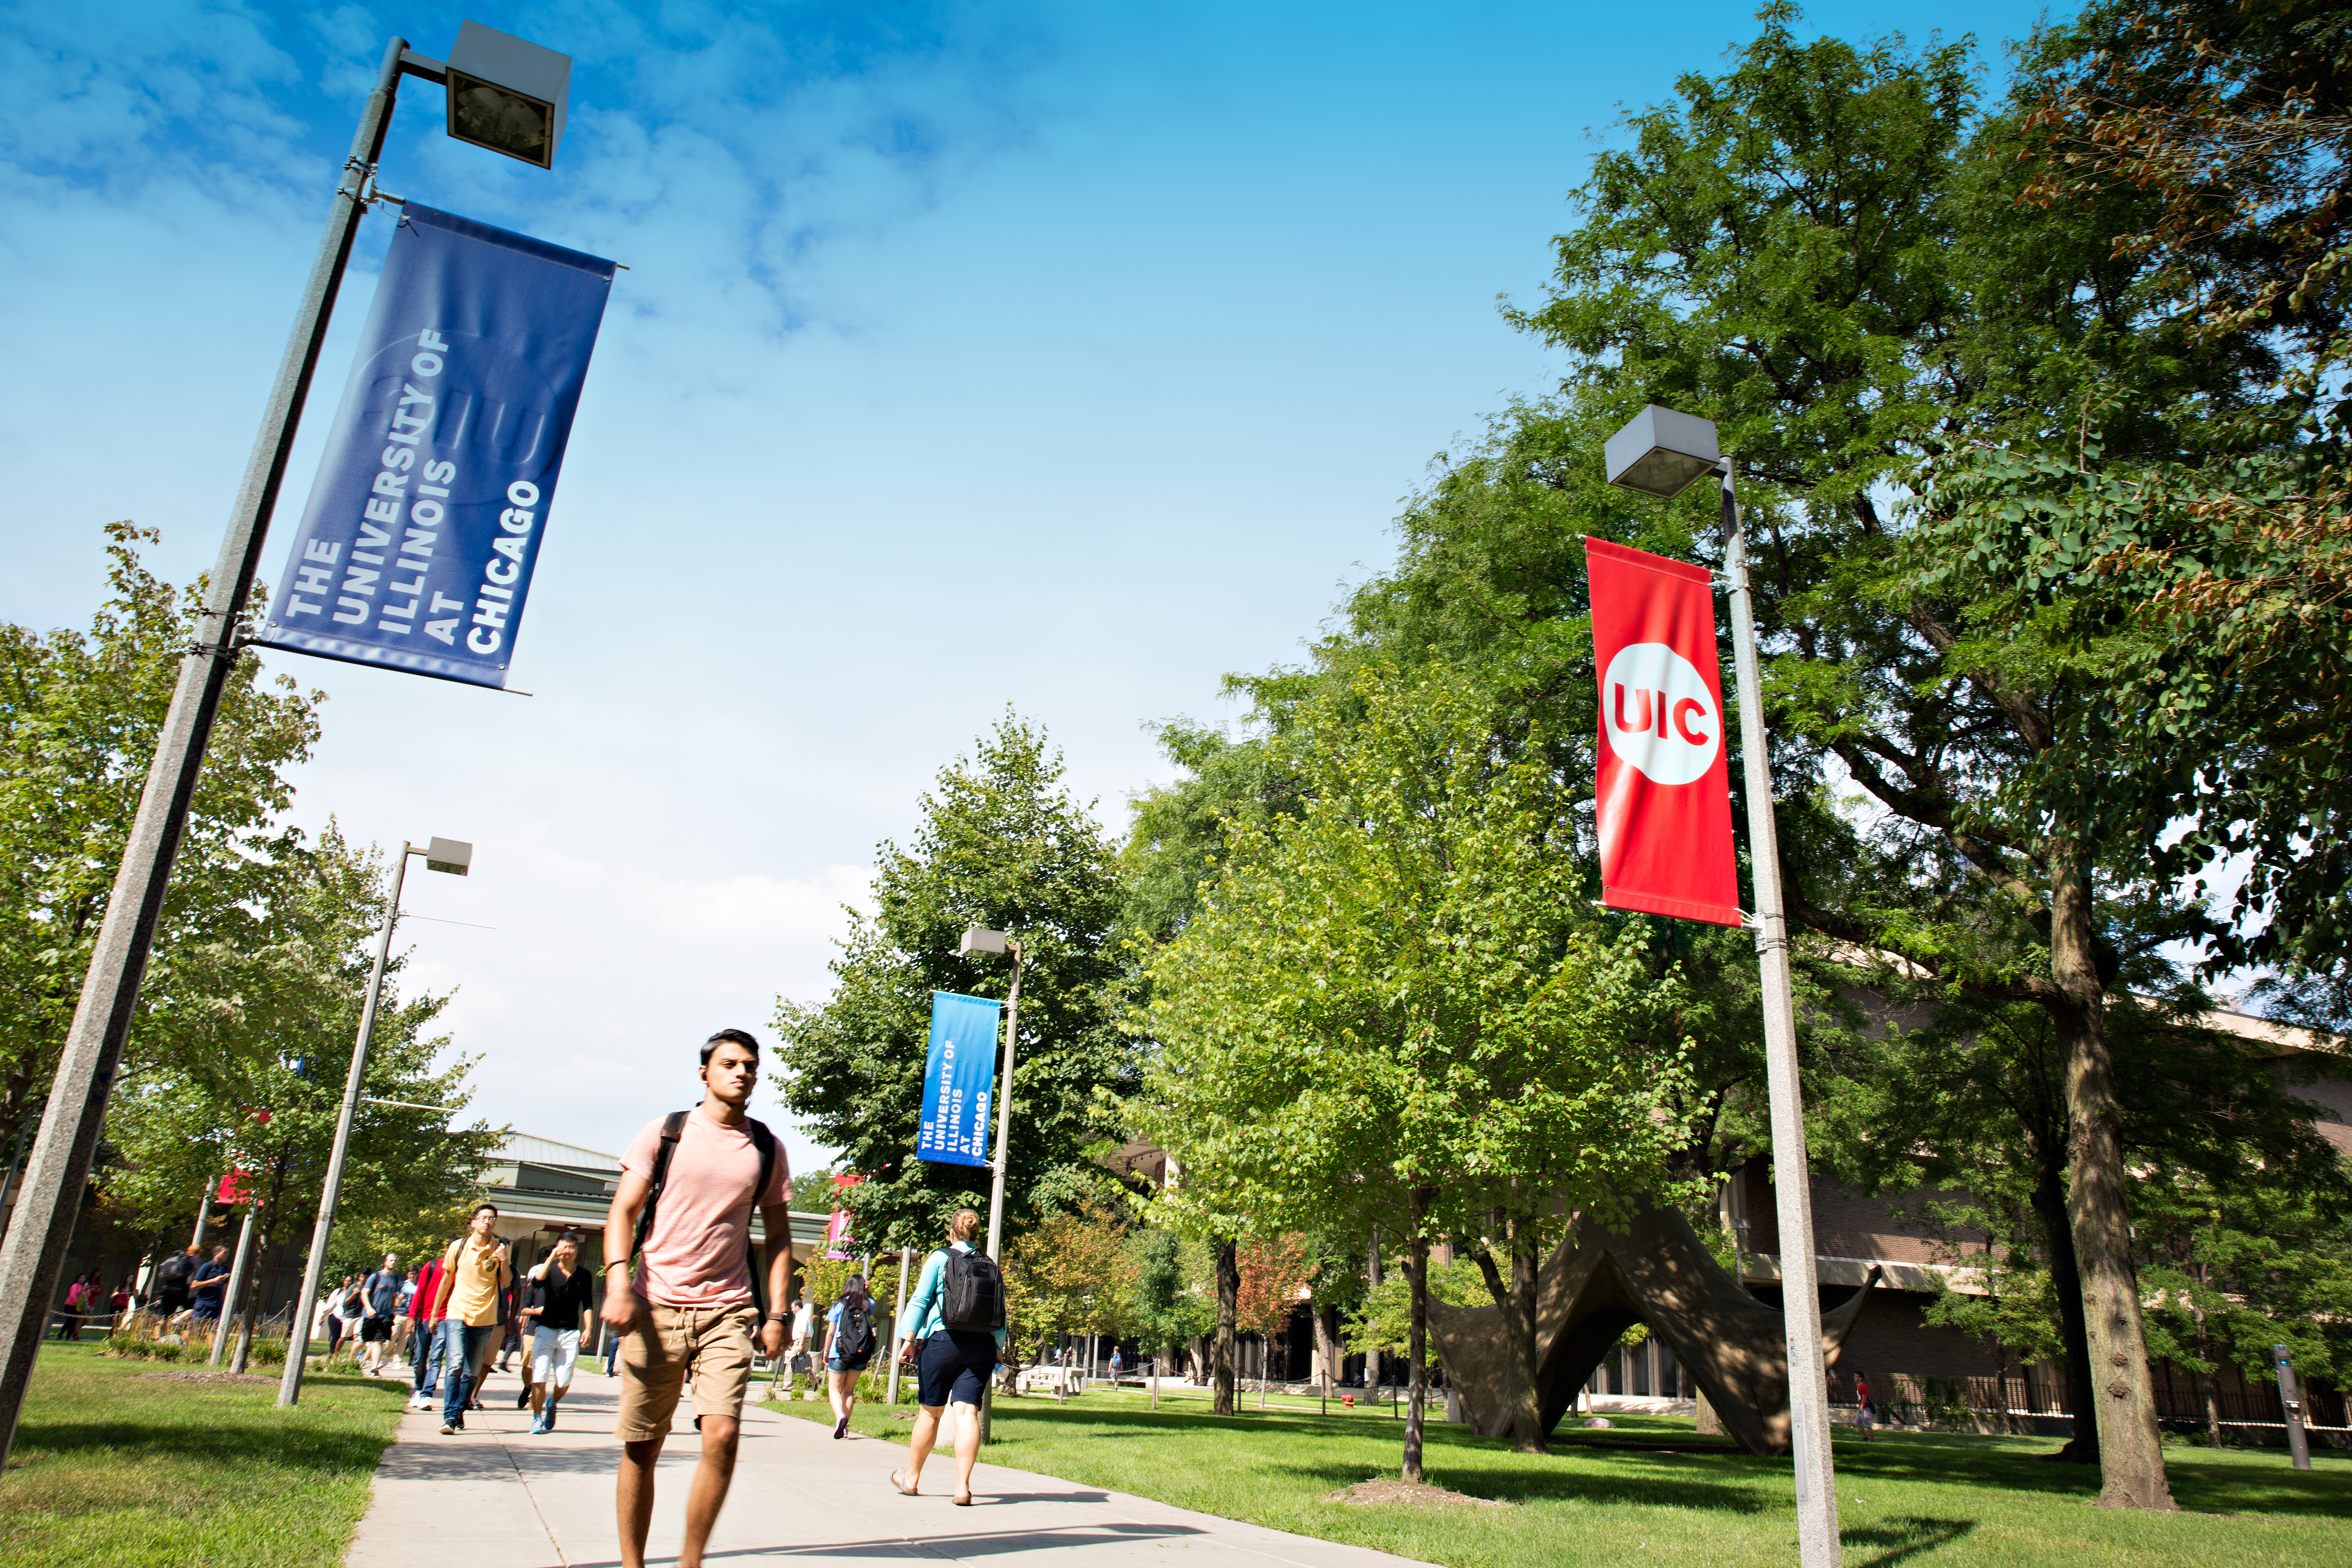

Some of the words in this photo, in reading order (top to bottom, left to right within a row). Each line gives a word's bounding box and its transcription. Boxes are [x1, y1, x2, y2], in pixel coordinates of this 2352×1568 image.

[332, 383, 433, 625] UNIVERSITY
[411, 328, 450, 377] OF
[285, 538, 342, 617] THE
[378, 458, 456, 634] ILLINOIS
[467, 480, 540, 655] CHICAGO
[423, 591, 465, 646] AT
[1614, 682, 1709, 746] UIC
[934, 1062, 953, 1150] UNIVERSITY
[944, 1040, 955, 1059] OF
[947, 1089, 963, 1152] ILLINOIS
[972, 1091, 987, 1157] CHICAGO
[921, 1121, 934, 1149] THE
[960, 1136, 971, 1154] AT
